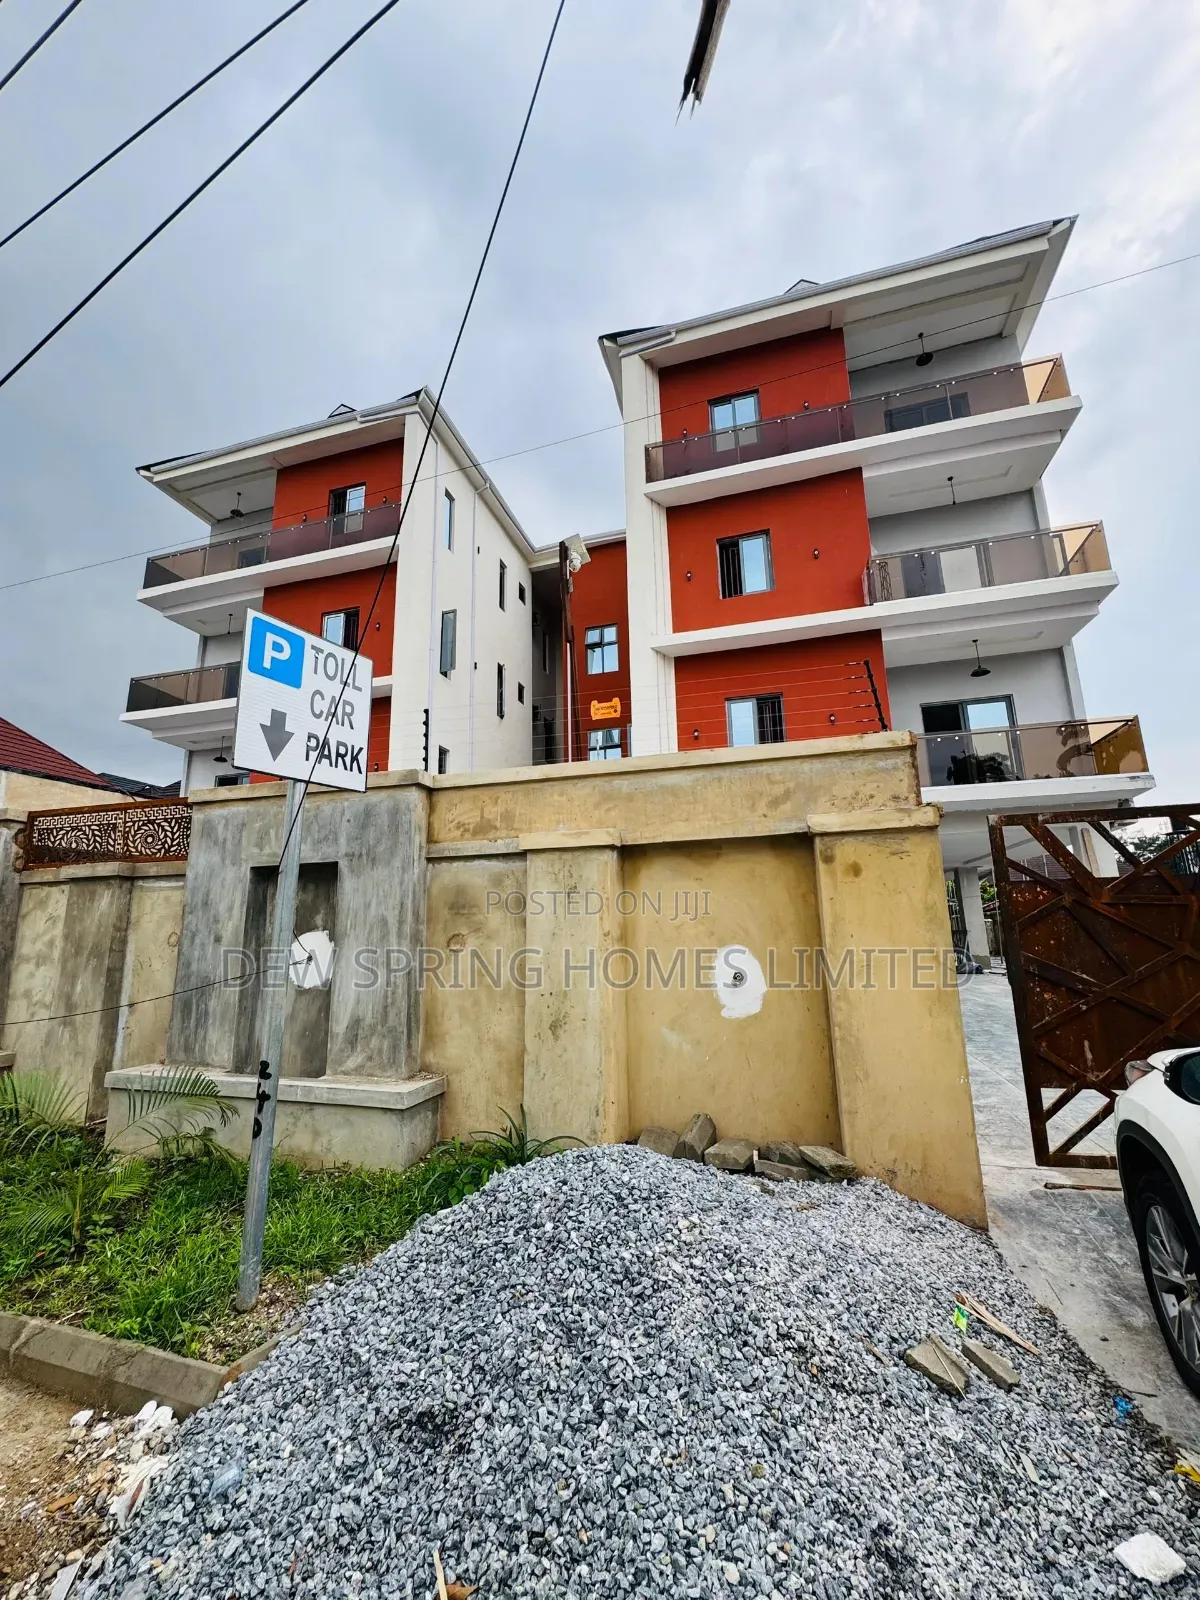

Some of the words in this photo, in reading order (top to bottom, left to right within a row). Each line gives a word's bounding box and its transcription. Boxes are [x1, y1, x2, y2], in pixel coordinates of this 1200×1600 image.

[262, 632, 291, 670] P
[310, 644, 363, 692] TOLL
[310, 689, 355, 730] CAR
[305, 732, 364, 775] PARK
